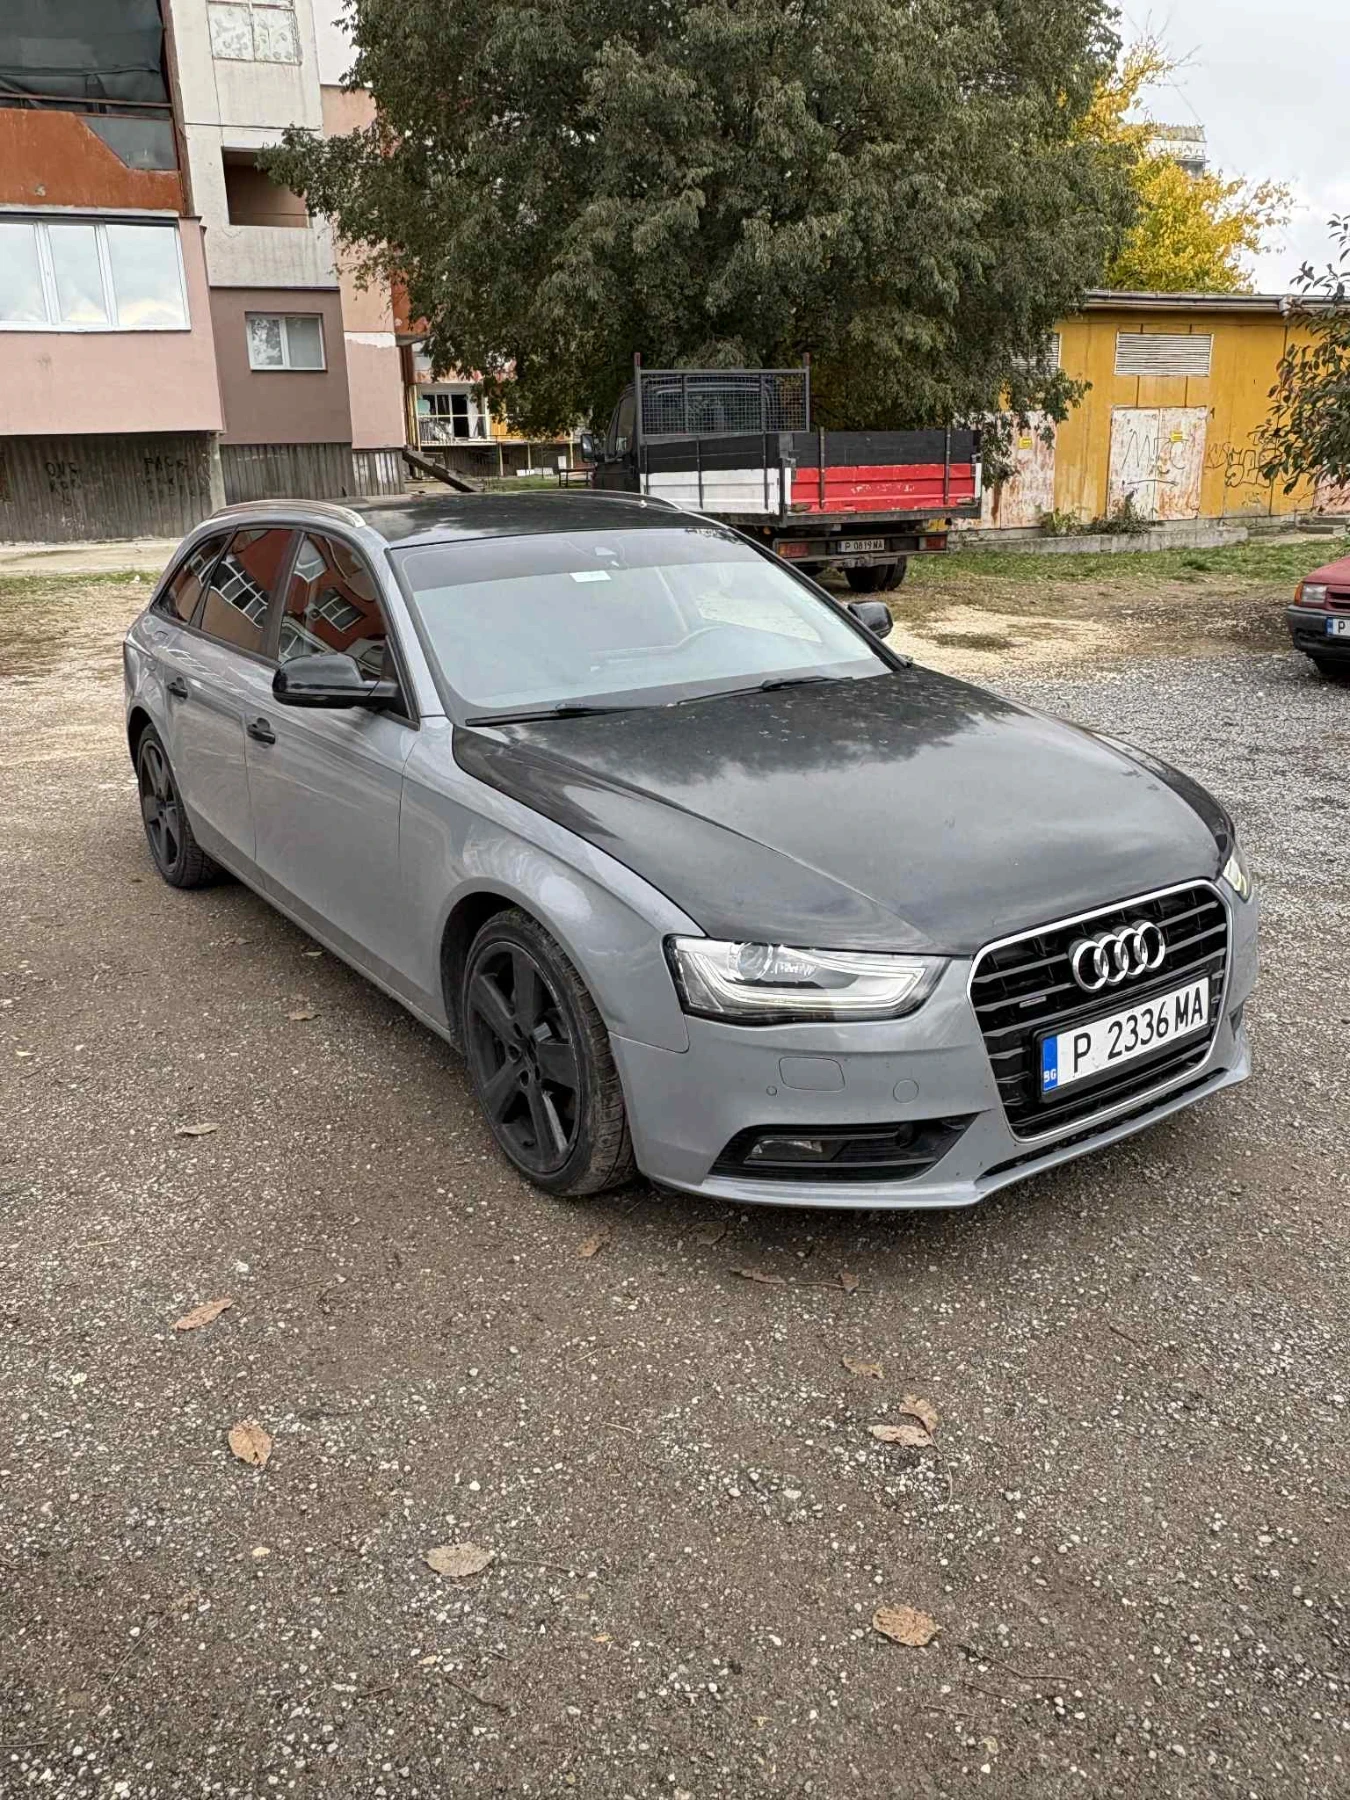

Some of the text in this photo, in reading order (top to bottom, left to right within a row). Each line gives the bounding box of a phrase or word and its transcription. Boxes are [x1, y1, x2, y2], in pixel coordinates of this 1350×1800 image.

[845, 542, 851, 551] P
[1074, 986, 1203, 1073] P 2336 MA
[1044, 1069, 1056, 1083] BG
